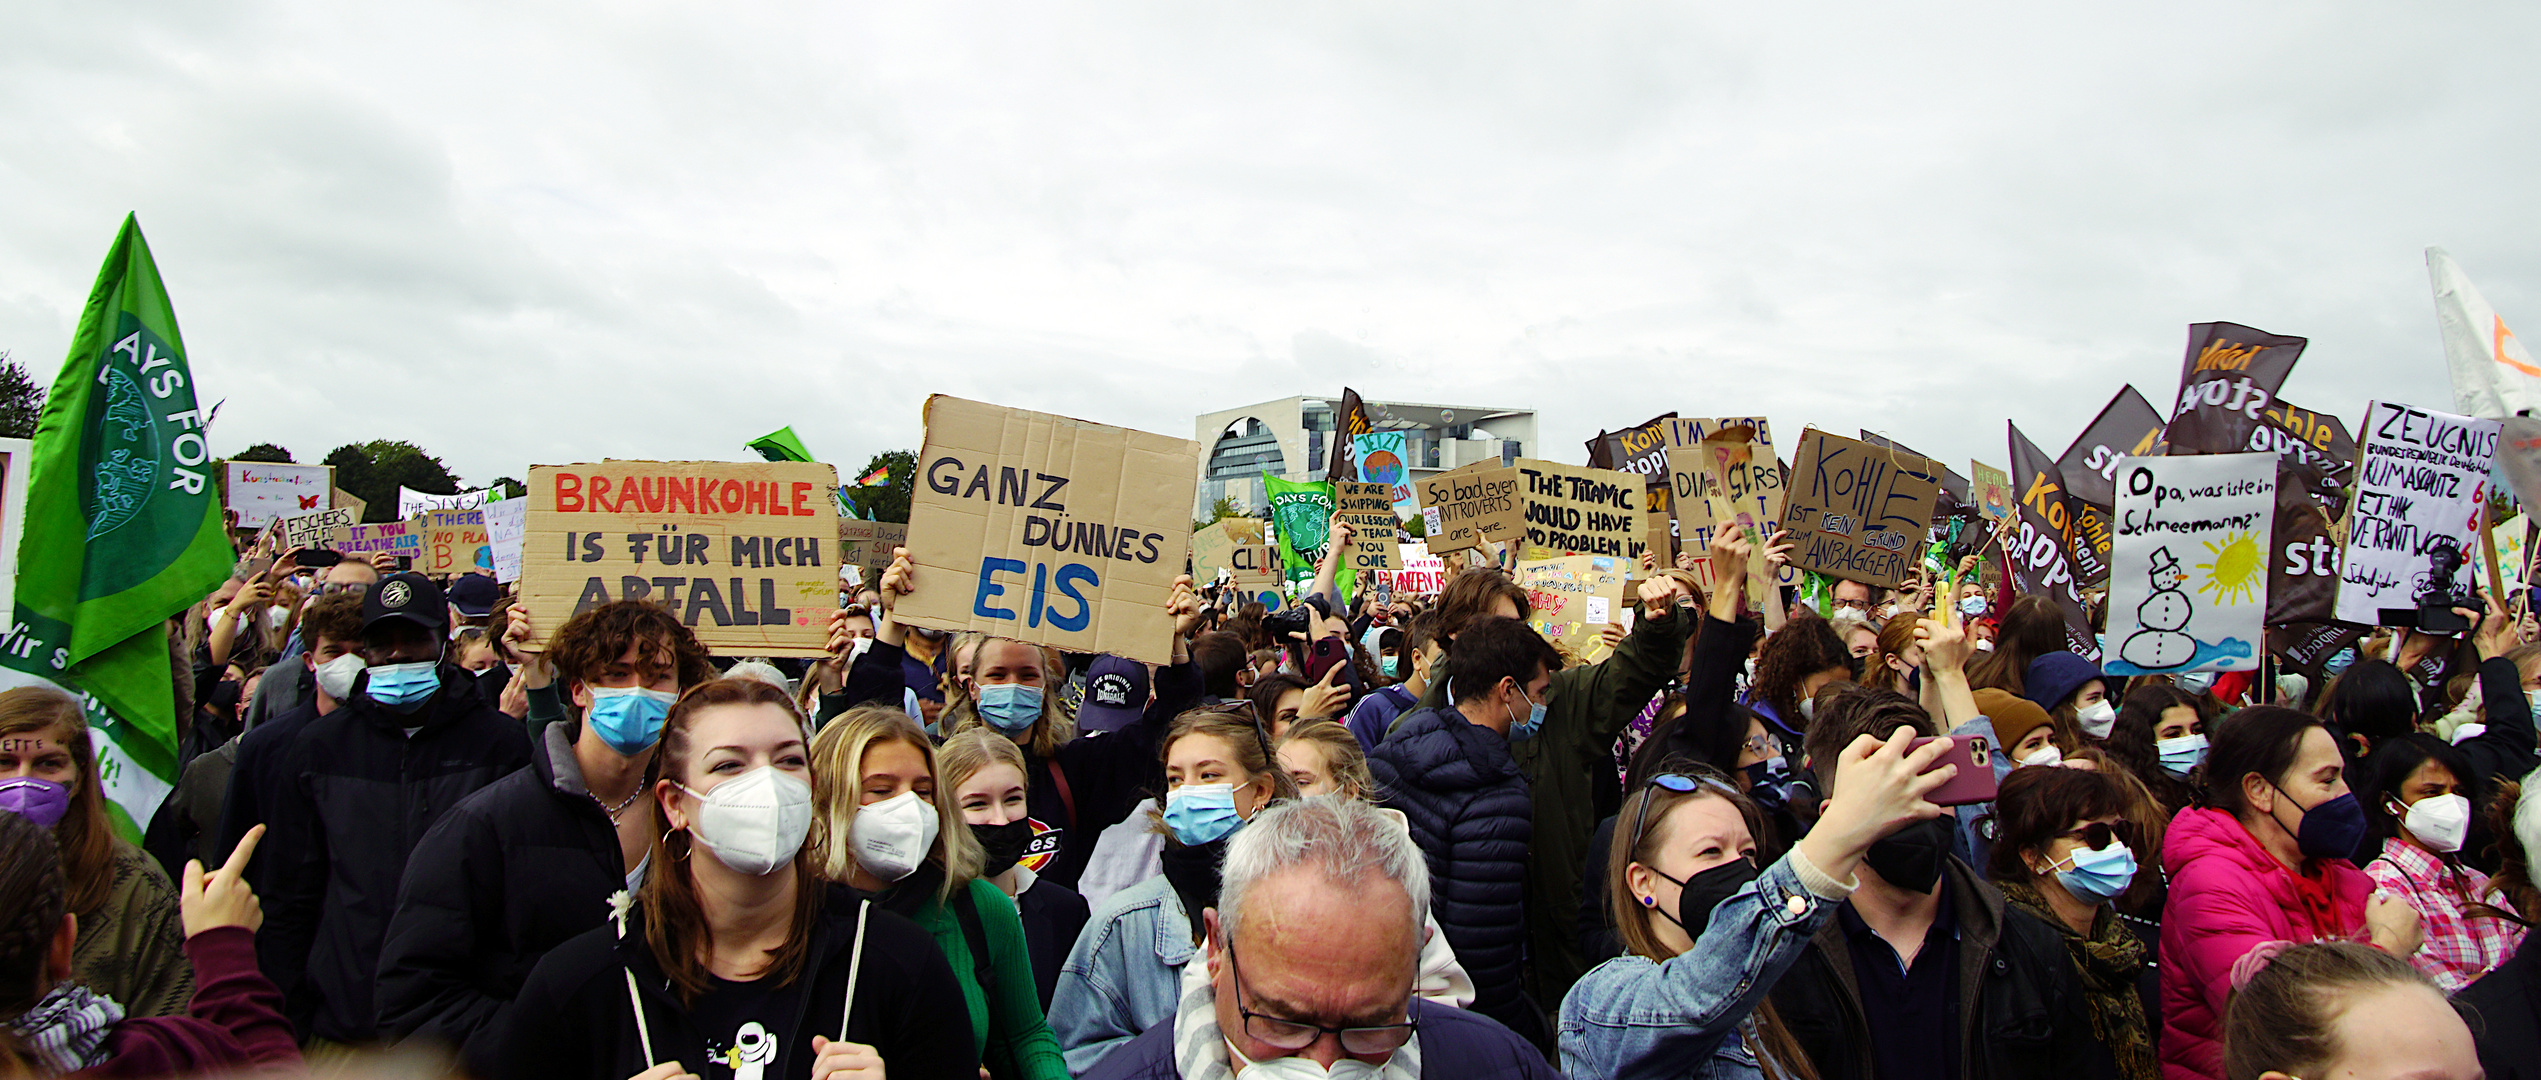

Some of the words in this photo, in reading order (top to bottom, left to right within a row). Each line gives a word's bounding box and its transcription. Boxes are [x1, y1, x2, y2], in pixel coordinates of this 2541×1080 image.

[112, 330, 184, 400] AYS
[167, 409, 206, 496] FOR
[1673, 420, 1705, 447] I'M
[2377, 402, 2497, 459] ZEUGNIS
[1356, 432, 1405, 455] JETZT
[2083, 443, 2127, 482] st
[927, 456, 1070, 512] GANZ
[1343, 484, 1359, 495] WE
[1364, 484, 1385, 495] ARE
[1429, 482, 1449, 505] So
[1486, 479, 1518, 497] even
[1520, 468, 1563, 498] THE
[1812, 436, 1938, 532] KOHLE
[2189, 484, 2224, 498] was
[2472, 480, 2485, 504] 6
[556, 473, 815, 517] BRAUNKOHLE
[1275, 493, 1306, 507] DAYS
[1340, 497, 1390, 512] SKIPPING
[403, 502, 424, 514] THE
[434, 512, 485, 526] THERE
[1438, 494, 1512, 522] INTROVERTS
[2021, 471, 2078, 562] Koh
[2357, 490, 2413, 521] ETHIK
[2467, 508, 2478, 532] 6
[288, 508, 351, 533] FISCHERS
[350, 526, 367, 540] IF
[377, 523, 406, 537] YOU
[1587, 511, 1633, 533] HAVE
[1788, 503, 1818, 523] IST
[1820, 512, 1857, 537] KEIN
[1864, 531, 1907, 551] GRUND
[290, 528, 319, 546] FRITZ
[395, 534, 419, 549] AIR
[433, 532, 454, 544] NO
[462, 532, 489, 544] PLA
[494, 525, 522, 541] NAT
[1022, 512, 1165, 564] DÜNNES
[1361, 528, 1393, 539] TEACH
[1450, 527, 1473, 541] are
[1548, 531, 1621, 557] PROBLEM
[1786, 528, 1813, 549] ZUM
[433, 544, 453, 569] B
[567, 532, 605, 563] IS
[627, 524, 710, 566] FÜR
[731, 536, 821, 568] MICH
[1357, 541, 1384, 553] YOU
[2461, 542, 2472, 565] 6
[1356, 554, 1388, 568] ONE
[1416, 559, 1442, 568] KEIN
[973, 555, 1100, 633] EIS
[1527, 589, 1568, 617] WHY
[1104, 673, 1133, 693] ORIGINAL
[1028, 835, 1058, 854] es
